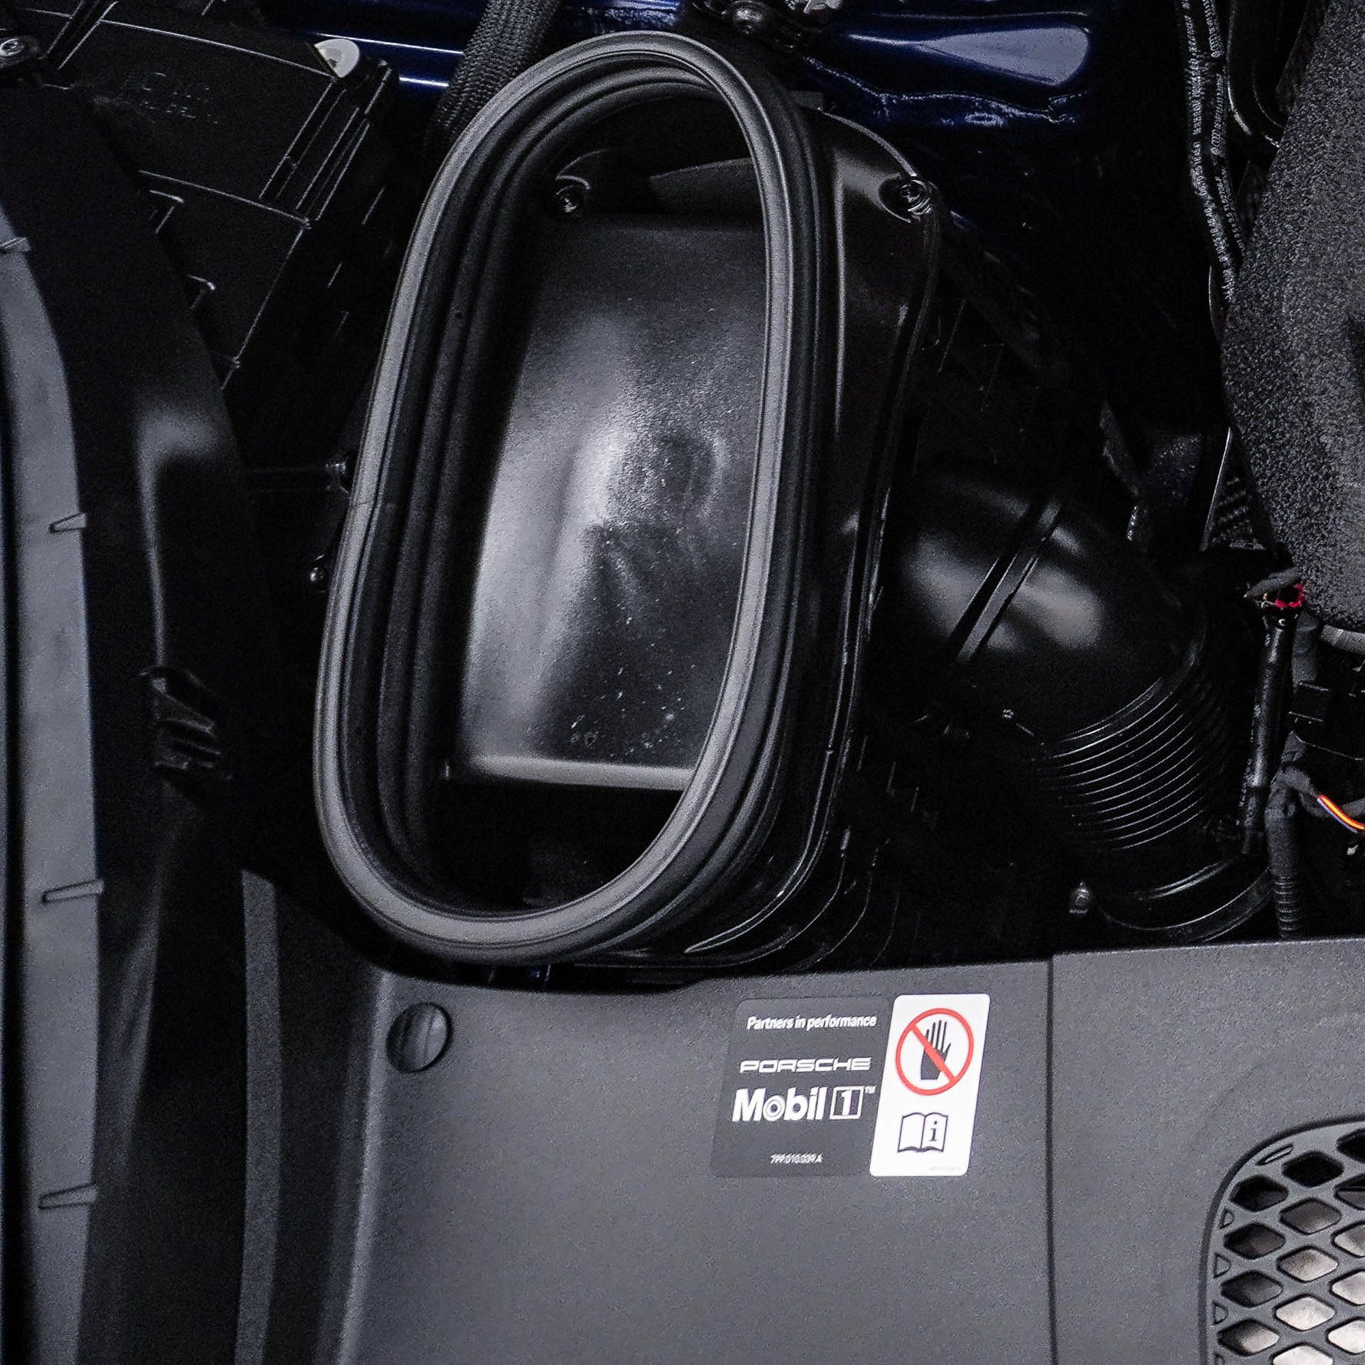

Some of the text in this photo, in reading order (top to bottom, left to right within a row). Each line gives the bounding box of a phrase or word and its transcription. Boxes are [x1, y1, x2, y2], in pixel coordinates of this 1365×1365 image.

[746, 1014, 877, 1032] Partners in performance
[739, 1057, 872, 1074] PORSCHE
[731, 1085, 827, 1123] Mobil
